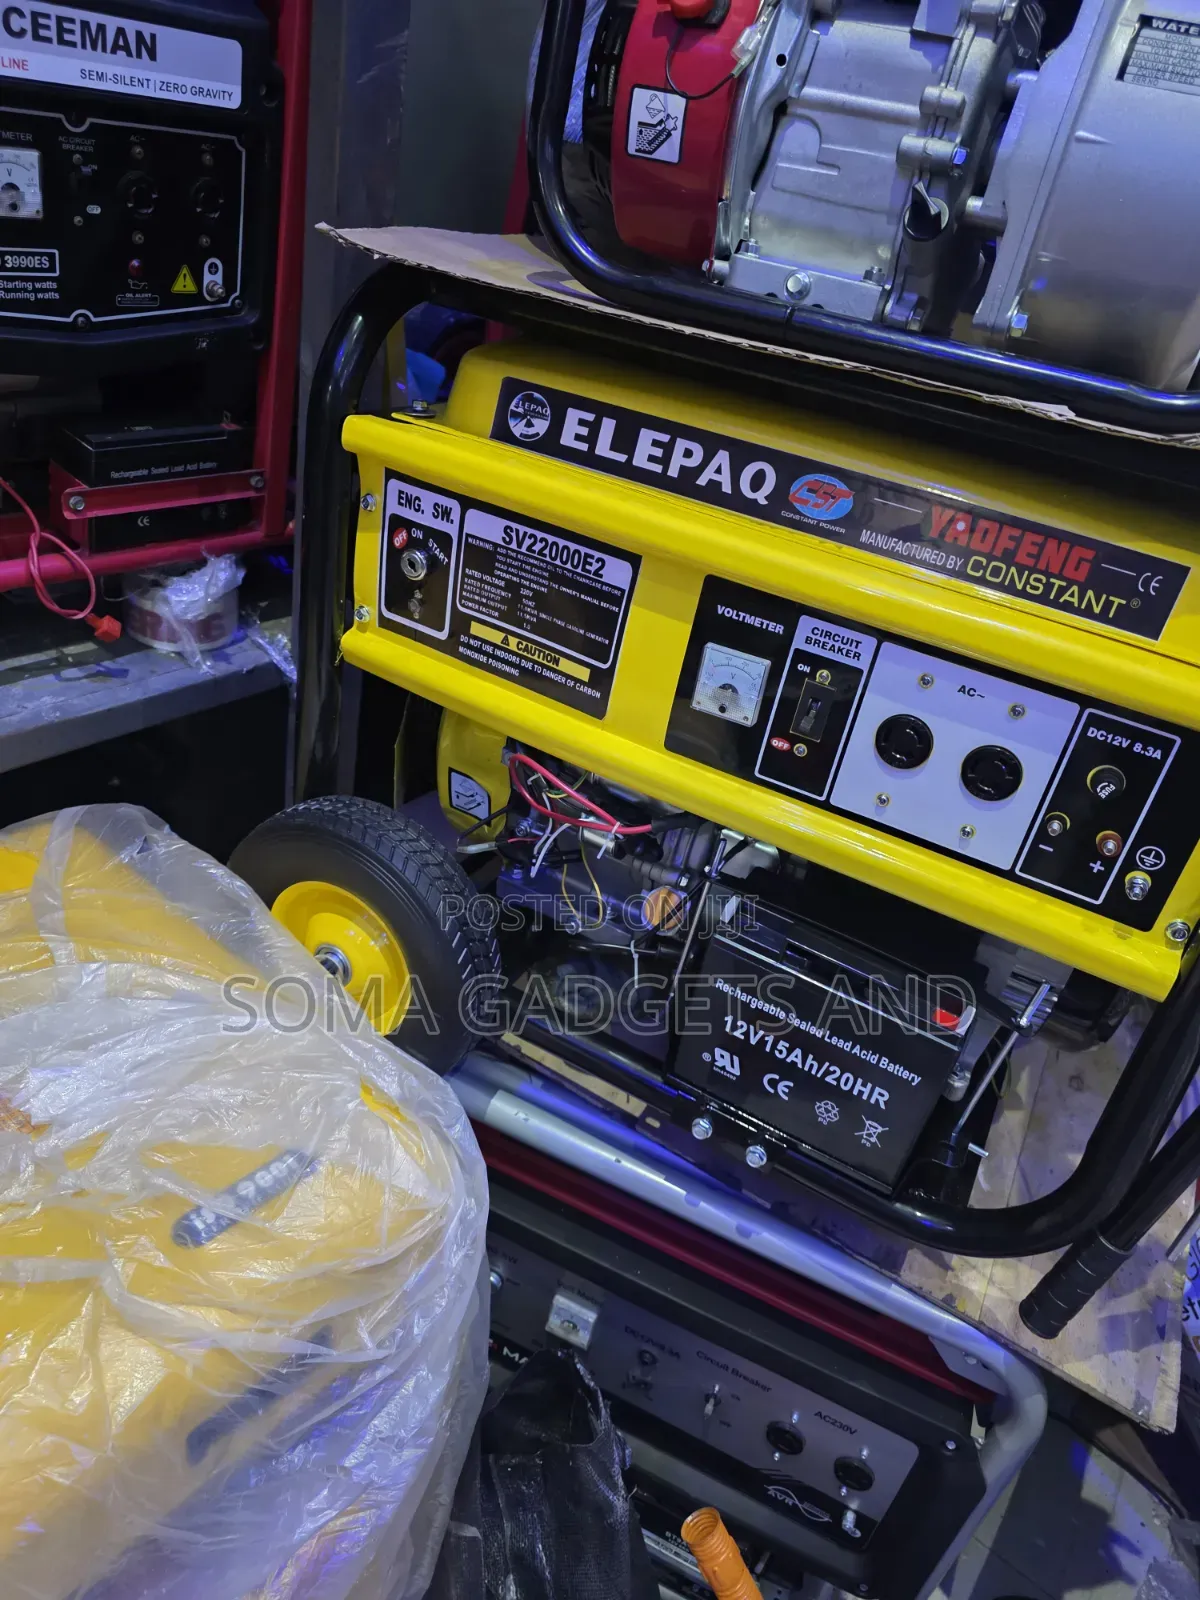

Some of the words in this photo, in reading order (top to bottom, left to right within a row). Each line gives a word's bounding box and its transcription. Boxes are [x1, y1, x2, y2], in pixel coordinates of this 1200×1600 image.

[2, 6, 157, 61] CEEMAN
[2, 57, 29, 71] LINE
[80, 69, 151, 90] SEMI-SILENT
[159, 82, 188, 95] ZERO
[191, 86, 233, 102] GRAVITY
[4, 255, 50, 268] 3990ES
[34, 281, 57, 290] watts
[37, 291, 60, 300] watts
[559, 407, 777, 505] ELEPAQ
[398, 489, 424, 514] ENG.
[432, 502, 454, 524] SW.
[411, 528, 423, 539] ON
[781, 510, 818, 525] CONSTANT
[820, 522, 846, 534] POWER
[394, 530, 408, 547] OFF
[428, 538, 449, 565] START
[501, 525, 606, 579] SV22000E2
[860, 529, 945, 566] MANUFACTURED
[946, 555, 965, 571] BY
[928, 503, 1096, 582] YAOFENG
[465, 568, 481, 579] RATED
[482, 573, 505, 587] VOLTAGE
[966, 555, 1126, 618] CONSTANT
[717, 604, 784, 635] VOLTMETER
[804, 635, 862, 662] BREAKER
[811, 626, 862, 650] CIRCUIT
[458, 645, 487, 663] MONOXIDE
[488, 658, 519, 677] POISONING
[460, 634, 468, 643] DO
[469, 638, 482, 648] NOT
[482, 643, 494, 653] USE
[494, 647, 520, 664] INDOORS
[521, 659, 533, 670] DUE
[533, 664, 541, 673] TO
[542, 668, 566, 685] DANGER
[567, 680, 575, 688] OF
[575, 683, 601, 699] CARBON
[516, 641, 561, 667] CAUTION
[797, 663, 811, 673] ON
[772, 739, 791, 750] OFF
[1087, 727, 1131, 749] DC12V
[1133, 742, 1163, 760] 8.3A
[1098, 783, 1116, 799] FUSE
[715, 978, 785, 1020] Rechargeable
[787, 1013, 824, 1039] Sealed
[825, 1032, 851, 1052] Lead
[852, 1045, 879, 1065] Acid
[879, 1057, 922, 1086] Battery
[724, 1015, 890, 1110] 12V15Ah/20HR
[696, 1350, 730, 1373] Circuit
[731, 1367, 772, 1393] Breaker
[814, 1411, 858, 1435] AC230V
